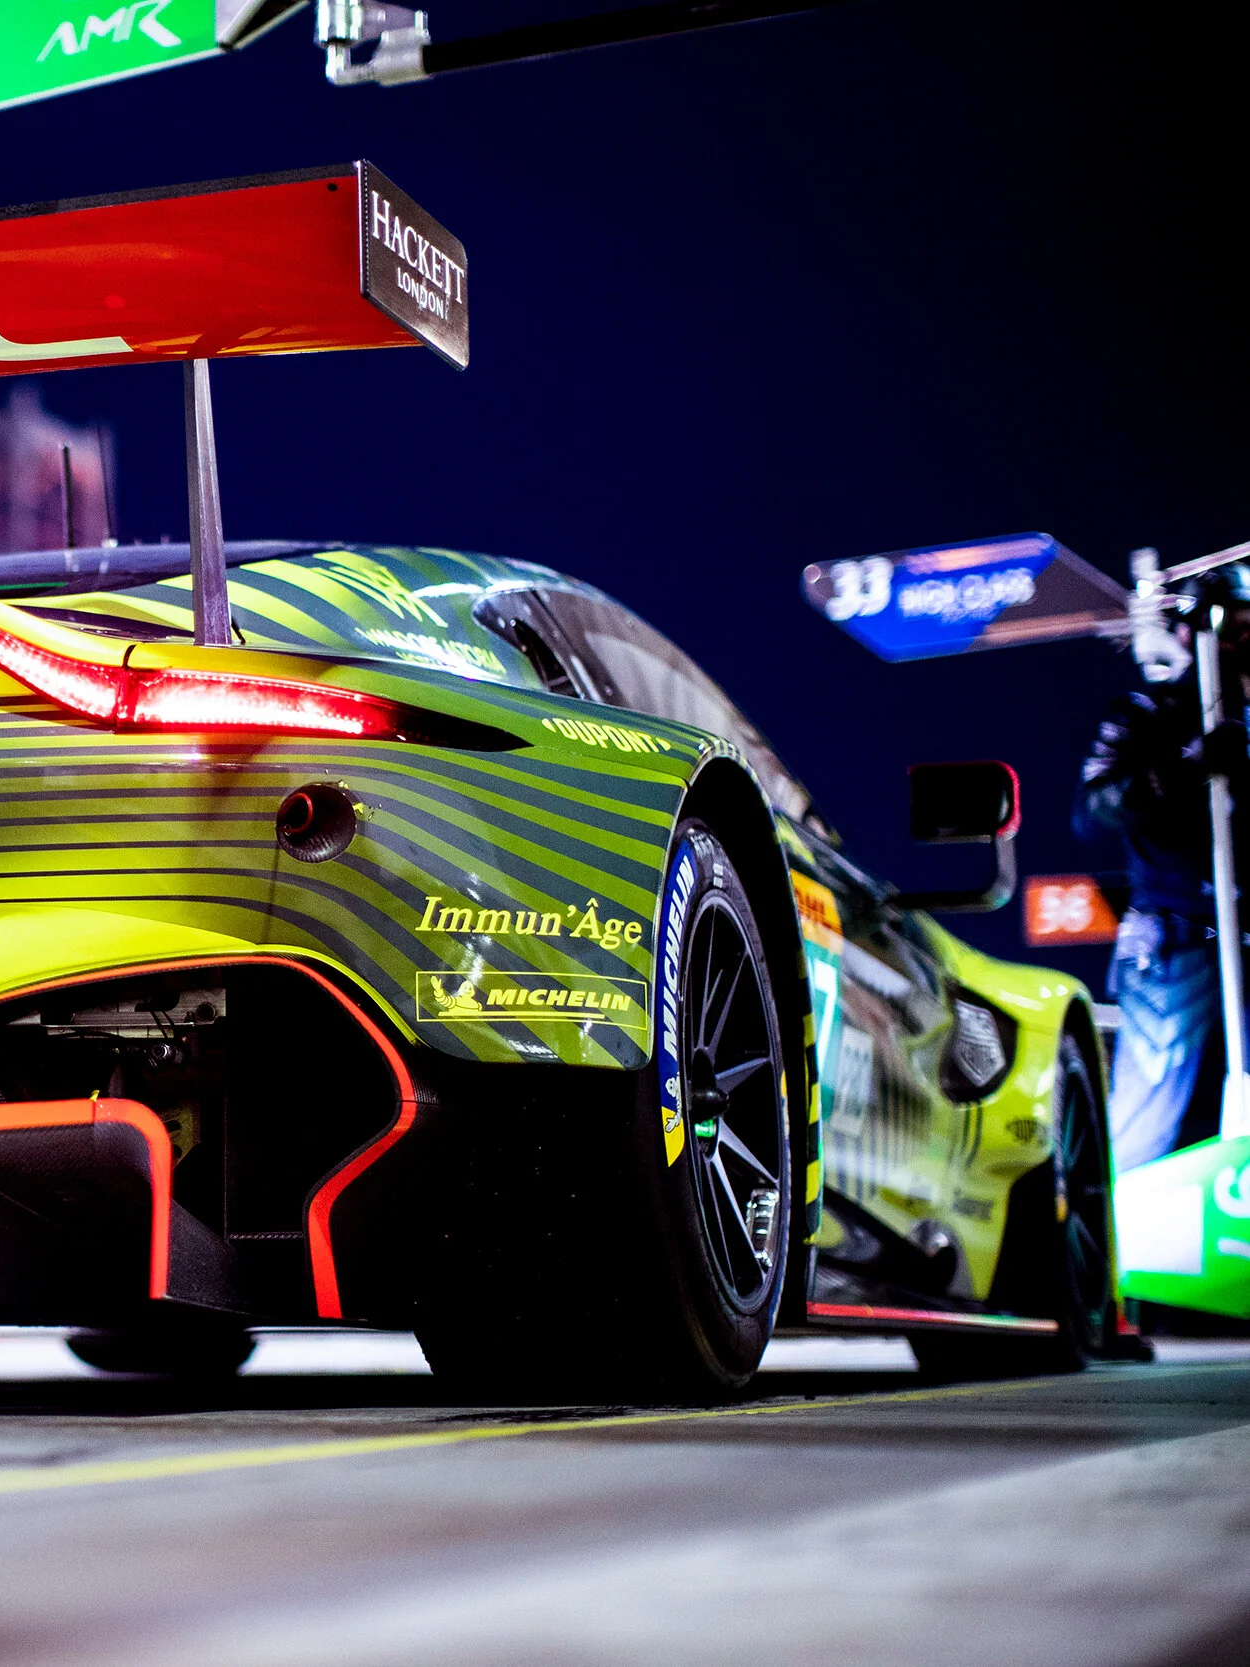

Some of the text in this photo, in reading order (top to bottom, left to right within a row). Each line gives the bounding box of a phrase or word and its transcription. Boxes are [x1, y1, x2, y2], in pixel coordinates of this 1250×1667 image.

[371, 190, 465, 305] HACKETT
[396, 266, 445, 320] LONDON
[552, 718, 660, 753] DUPONT
[663, 855, 695, 1062] MICHELIN
[487, 987, 631, 1012] MICHELIN
